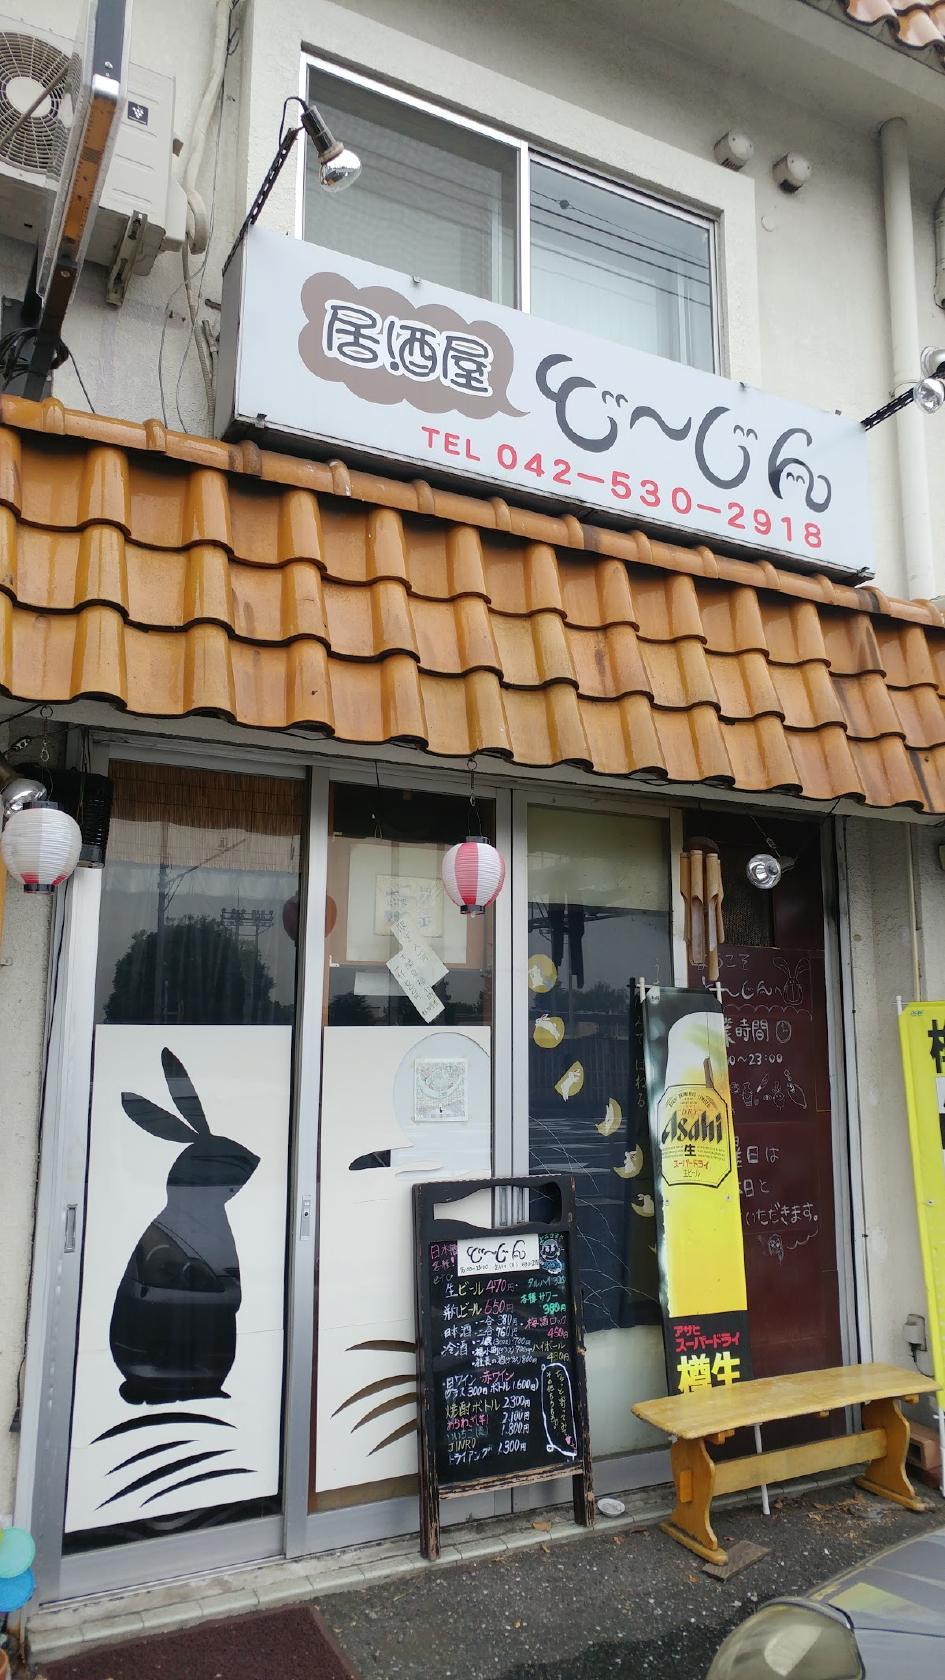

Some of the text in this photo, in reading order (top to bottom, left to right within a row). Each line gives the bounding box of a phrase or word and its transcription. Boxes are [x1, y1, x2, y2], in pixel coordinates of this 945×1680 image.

[325, 303, 490, 394] 居酒屋
[421, 426, 481, 462] TEL
[661, 1110, 723, 1145] Asahi
[684, 1143, 697, 1157] 生
[673, 1159, 710, 1170] スーパードライ
[673, 1325, 701, 1337] アサヒ
[674, 1331, 741, 1353] スーパードライ
[676, 1350, 741, 1393] 樽生
